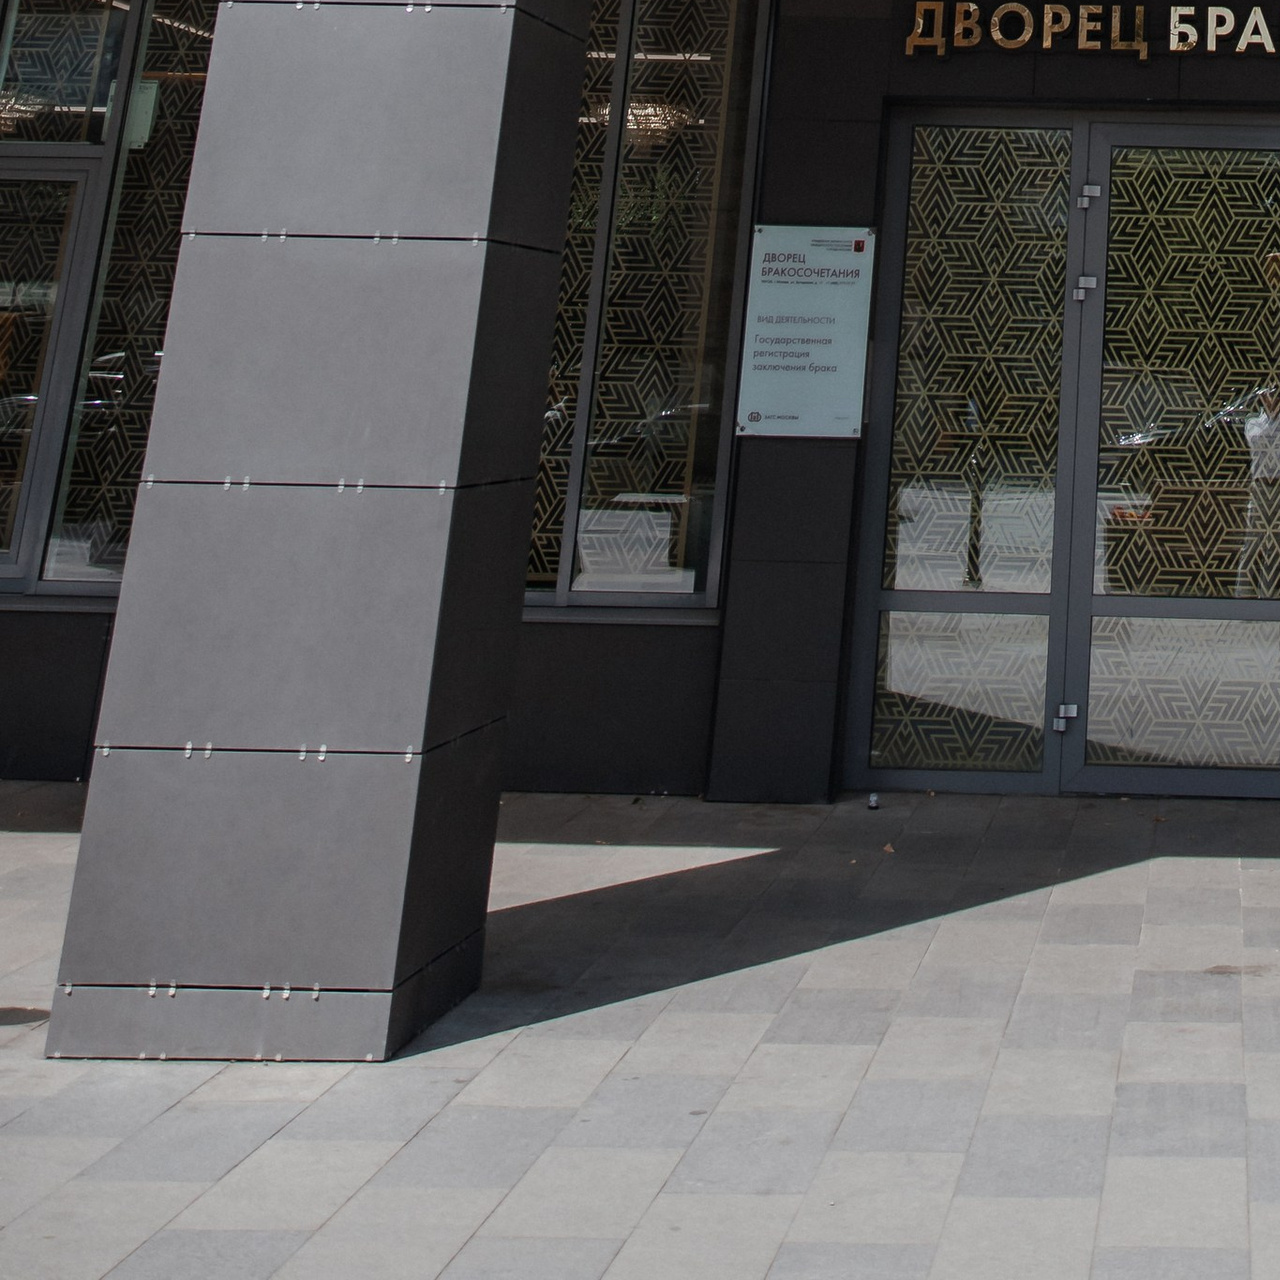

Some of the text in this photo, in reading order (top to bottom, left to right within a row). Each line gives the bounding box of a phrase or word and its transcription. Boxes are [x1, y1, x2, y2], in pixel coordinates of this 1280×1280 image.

[905, 1, 1148, 60] ДВОРЕЦ
[762, 252, 806, 264] ДВОРЕЦ
[761, 267, 861, 278] БРАКОСОЧЕТАНИЯ
[757, 315, 836, 325] ВИД ДЕЯТЕЛЬНОСТИ
[754, 334, 832, 346] Государственная
[753, 350, 810, 360] регистрация
[752, 362, 837, 374] заключения брака
